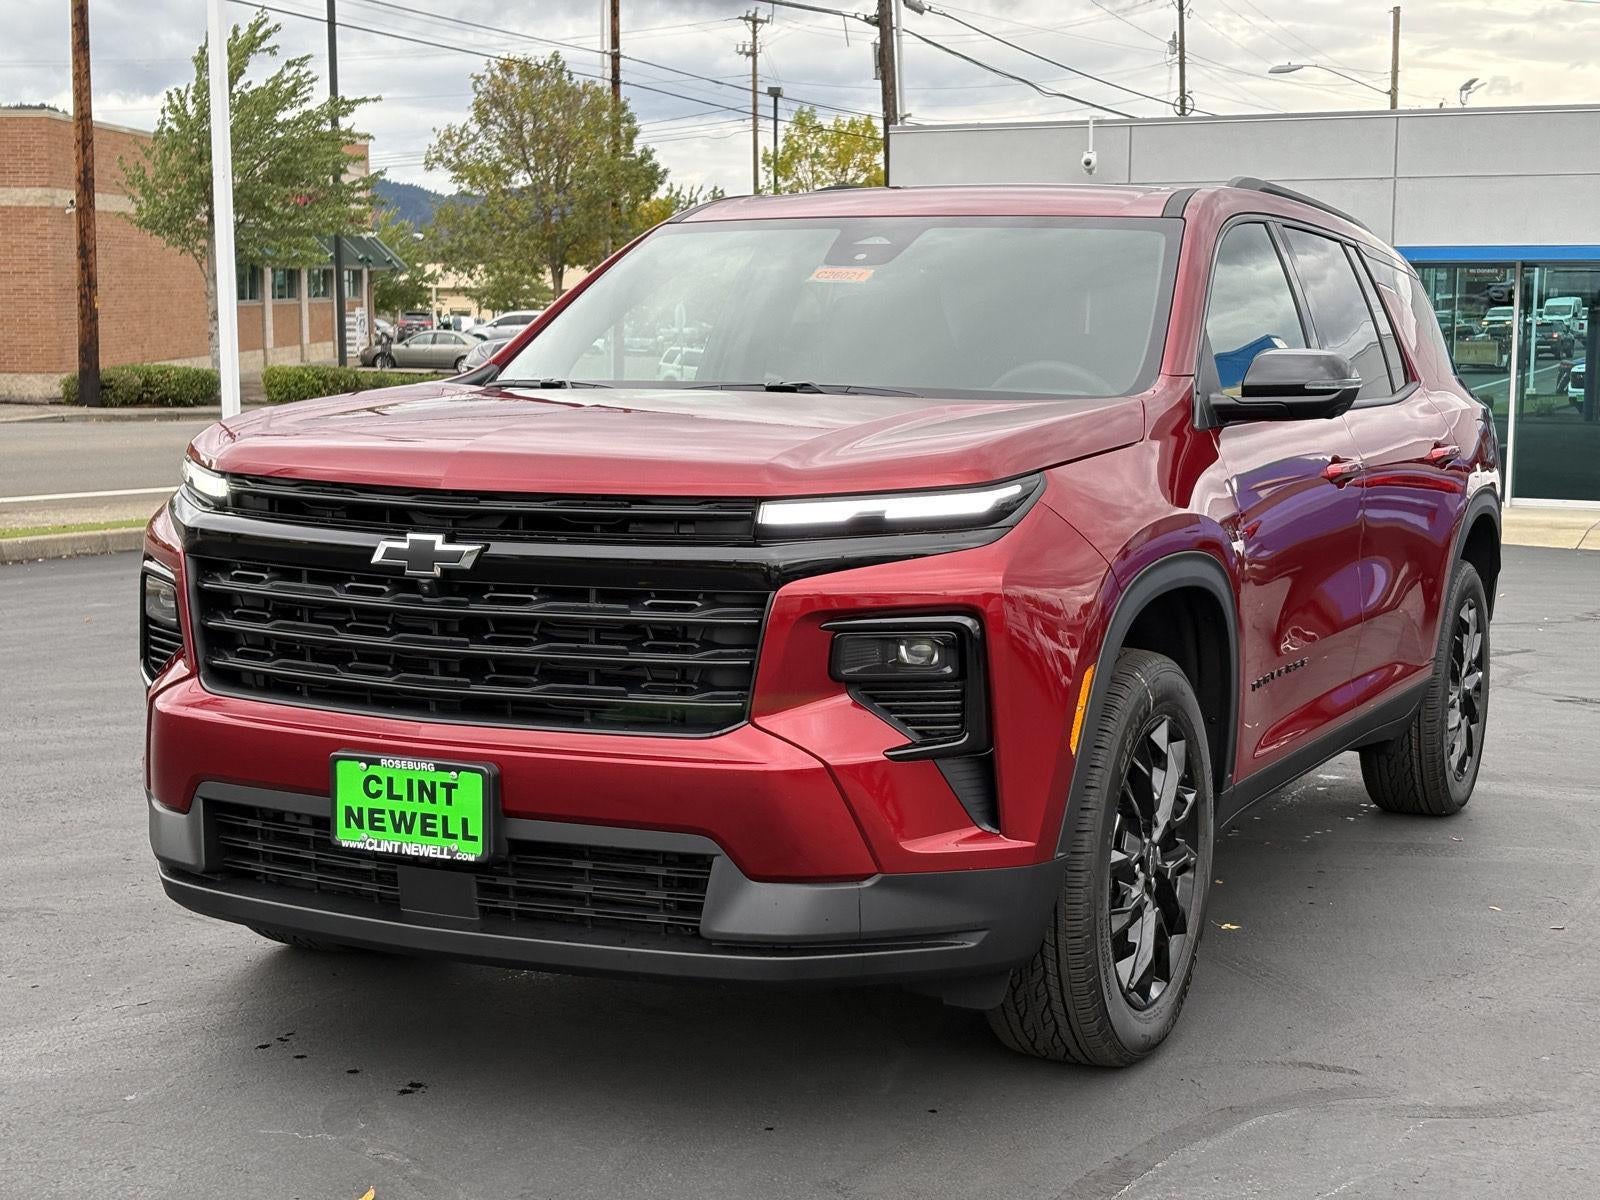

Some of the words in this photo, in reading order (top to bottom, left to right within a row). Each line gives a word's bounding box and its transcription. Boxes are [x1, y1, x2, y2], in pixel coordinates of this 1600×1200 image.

[380, 758, 435, 772] ROSEBURG
[362, 774, 459, 806] CLINT
[344, 805, 479, 842] NEWELL
